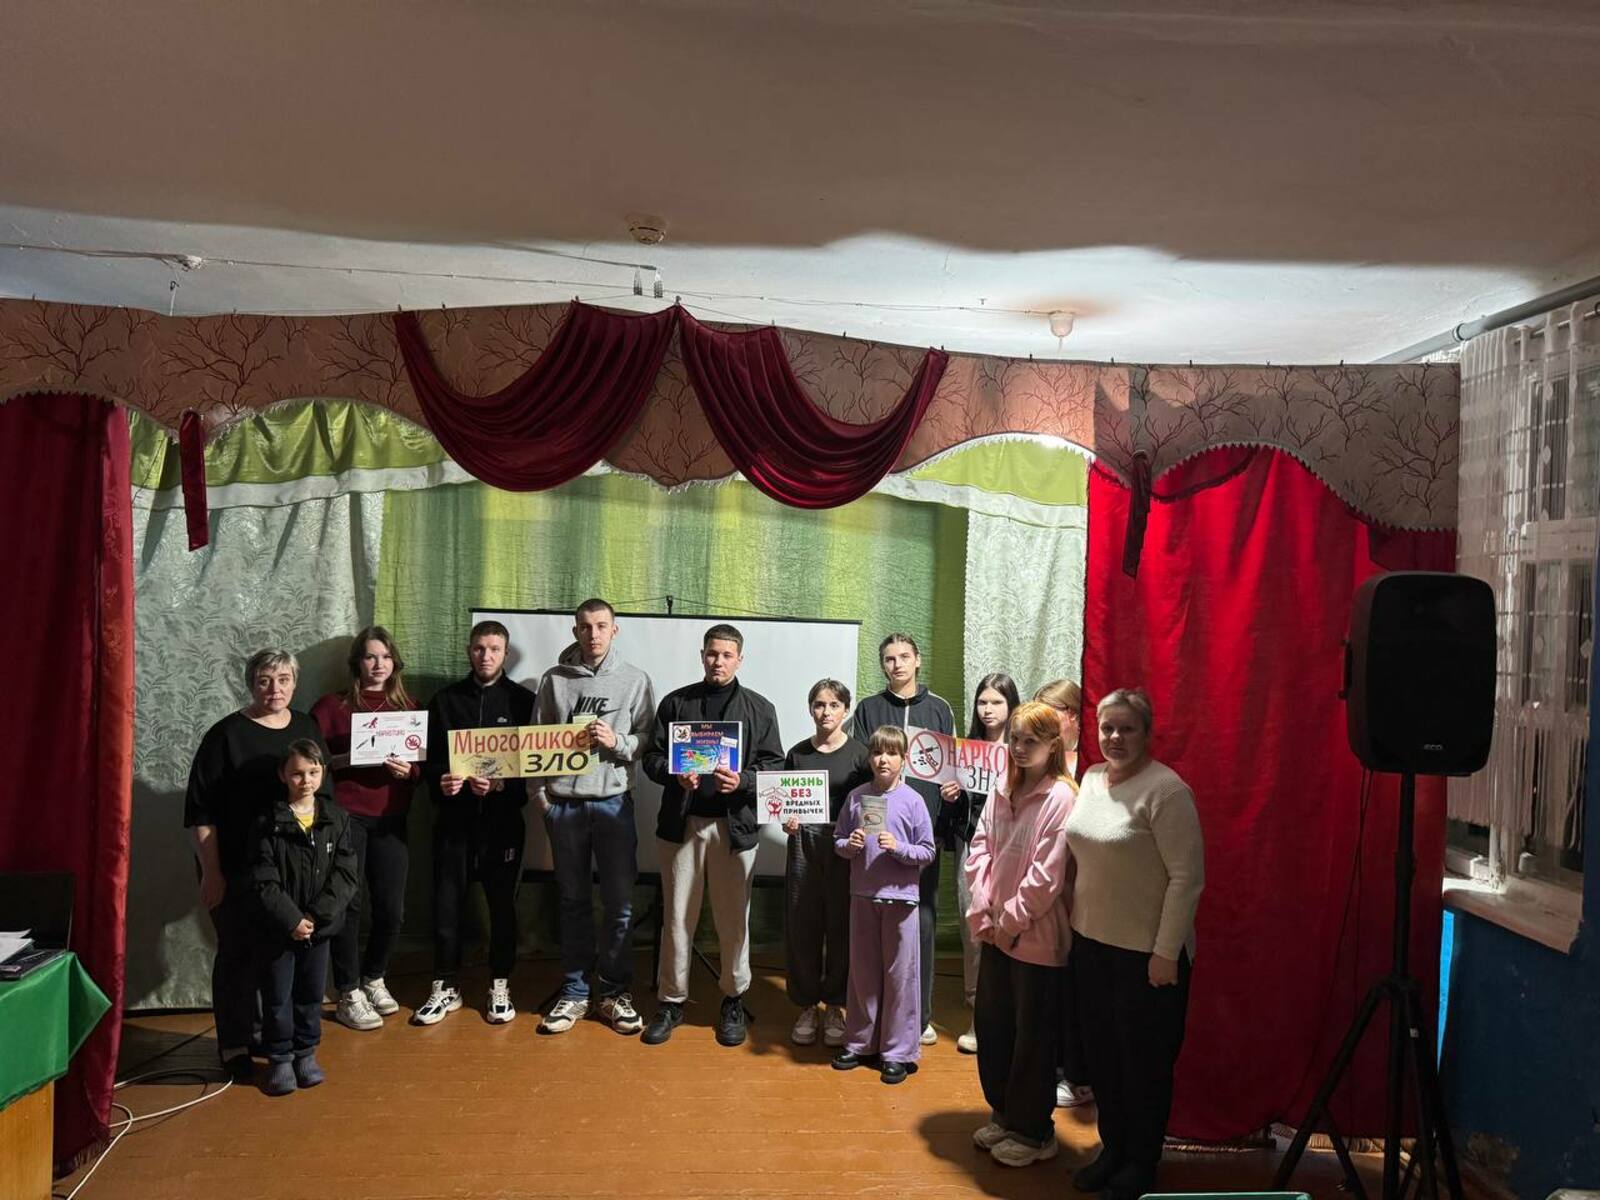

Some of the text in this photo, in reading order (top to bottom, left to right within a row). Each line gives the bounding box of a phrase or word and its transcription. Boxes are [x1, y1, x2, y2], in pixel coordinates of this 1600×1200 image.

[573, 696, 609, 714] NIKE
[454, 729, 589, 755] Многоликое
[946, 737, 1008, 774] НАРКО
[780, 777, 823, 787] ЖИЗНЬ
[790, 788, 812, 798] БЕЗ
